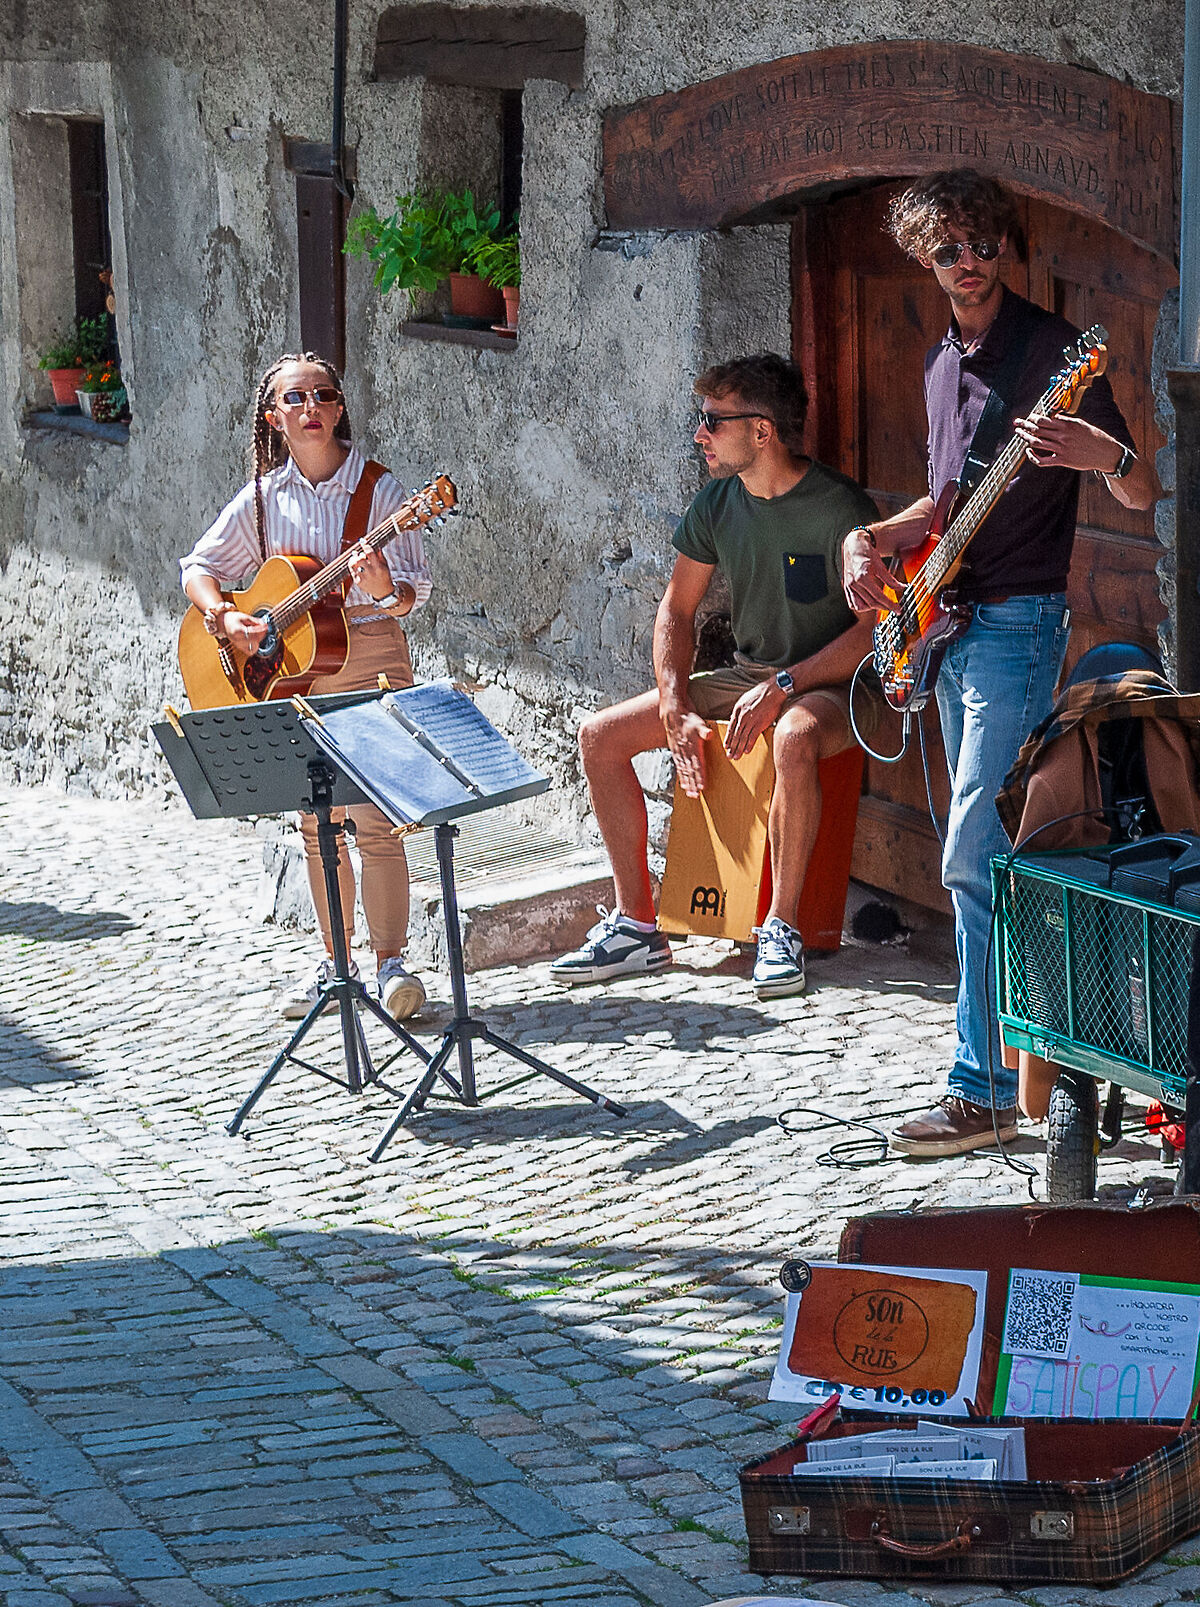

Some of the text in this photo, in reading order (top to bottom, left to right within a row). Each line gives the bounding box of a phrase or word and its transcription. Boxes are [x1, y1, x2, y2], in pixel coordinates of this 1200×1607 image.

[756, 73, 799, 110] SOIT
[808, 66, 834, 98] LE
[939, 61, 1087, 123] SACREMENT
[761, 135, 791, 168] PAR
[856, 120, 989, 159] SEBASTIEN
[1156, 1313, 1189, 1323] NOSTRO
[1157, 1335, 1174, 1343] TUO
[851, 1344, 898, 1369] RUE
[848, 1386, 867, 1401] €
[874, 1385, 947, 1408] 10,00
